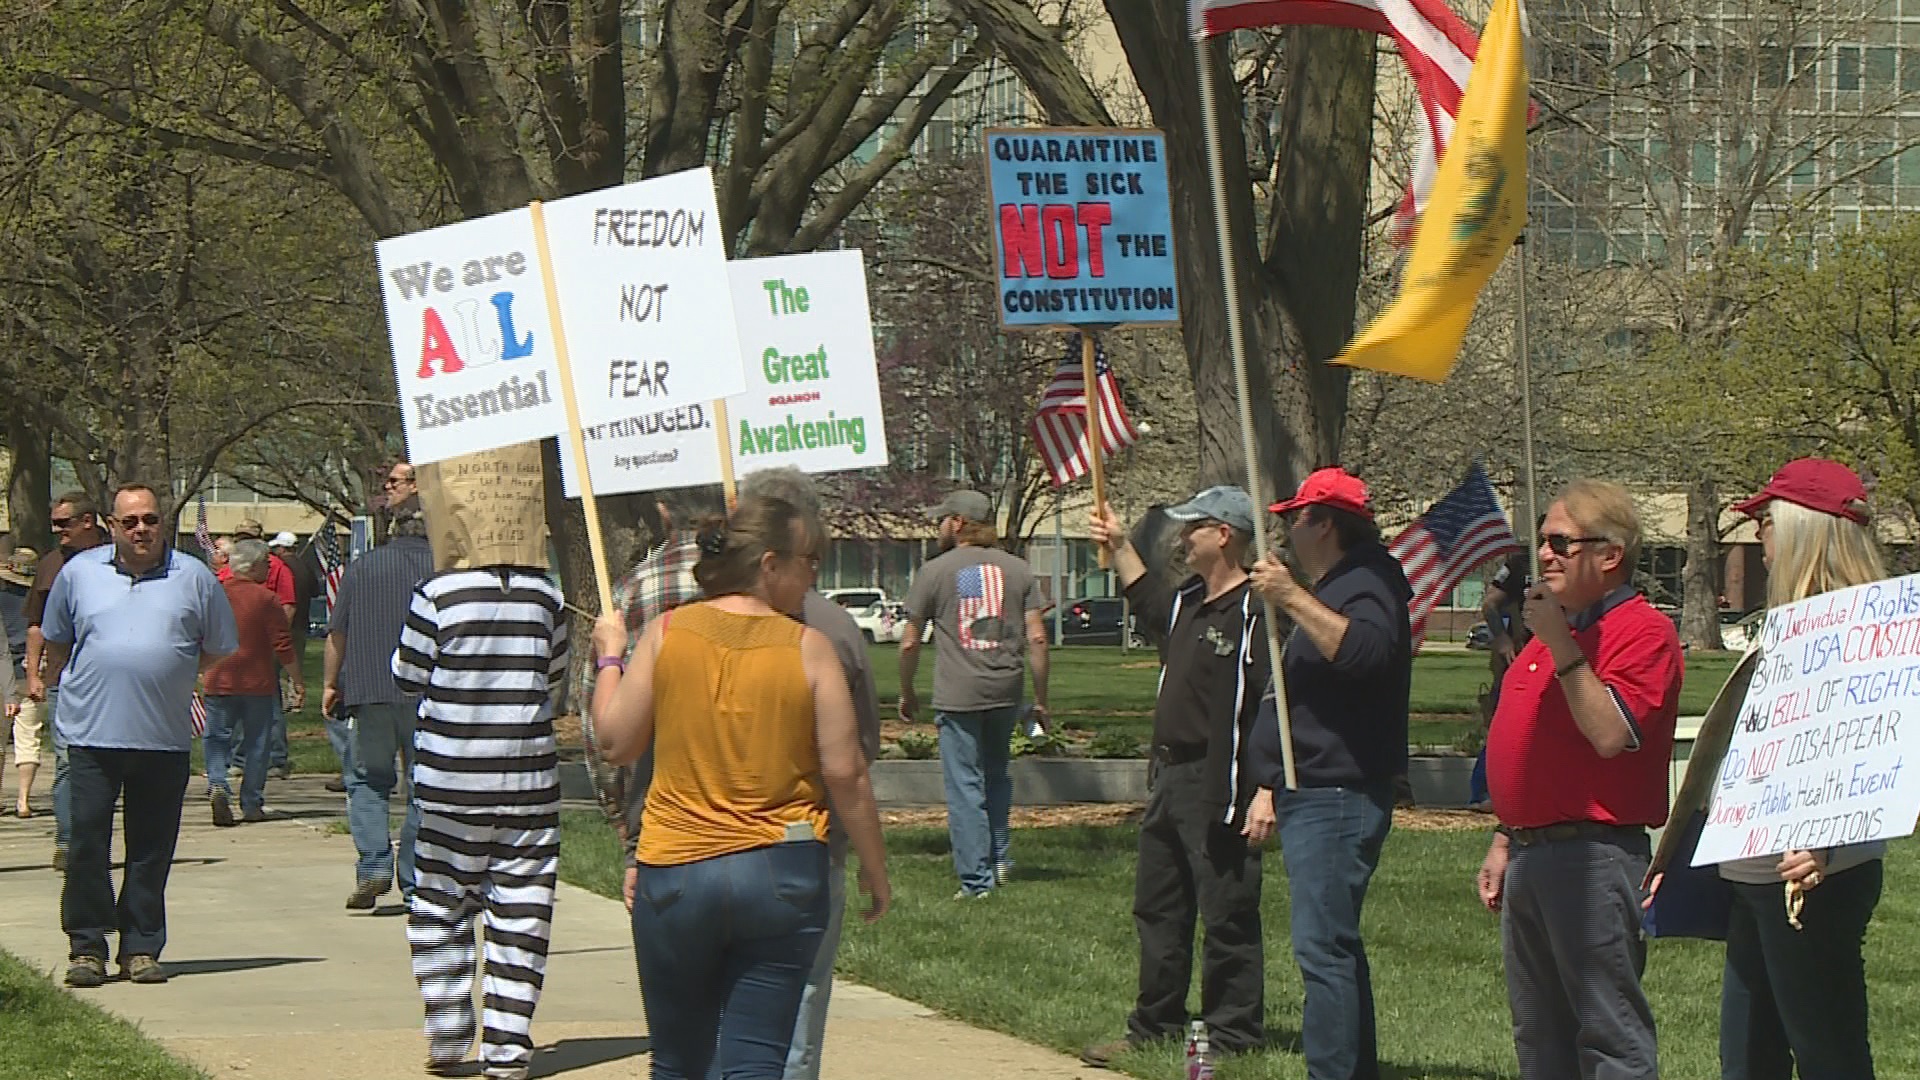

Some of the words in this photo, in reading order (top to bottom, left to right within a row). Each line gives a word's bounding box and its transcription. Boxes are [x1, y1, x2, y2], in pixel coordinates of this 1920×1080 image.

[994, 138, 1158, 163] QUARANTINE
[1017, 172, 1069, 196] THE
[1086, 172, 1144, 195] SICK
[593, 208, 705, 248] FREEDOM
[999, 201, 1112, 280] NOT
[1117, 234, 1167, 257] THE
[390, 261, 455, 301] We
[462, 251, 527, 287] are
[762, 277, 810, 316] The
[619, 283, 669, 322] NOT
[1004, 287, 1174, 313] CONSTITUTION
[416, 291, 534, 379] ALL
[609, 360, 670, 398] FEAR
[762, 343, 830, 384] Great
[413, 369, 552, 430] Essential
[739, 409, 867, 456] Awakening
[1762, 611, 1783, 654] My
[1751, 657, 1771, 696] By
[1772, 653, 1794, 685] The
[1802, 632, 1842, 675] USA
[1771, 687, 1812, 729] BILL
[1816, 678, 1845, 713] OF
[1746, 738, 1785, 777] NOT
[1786, 708, 1902, 768] DISAPPEAR
[1794, 768, 1845, 810] Health
[1740, 826, 1769, 857] NO
[1770, 806, 1884, 853] EXCEPTIONS
